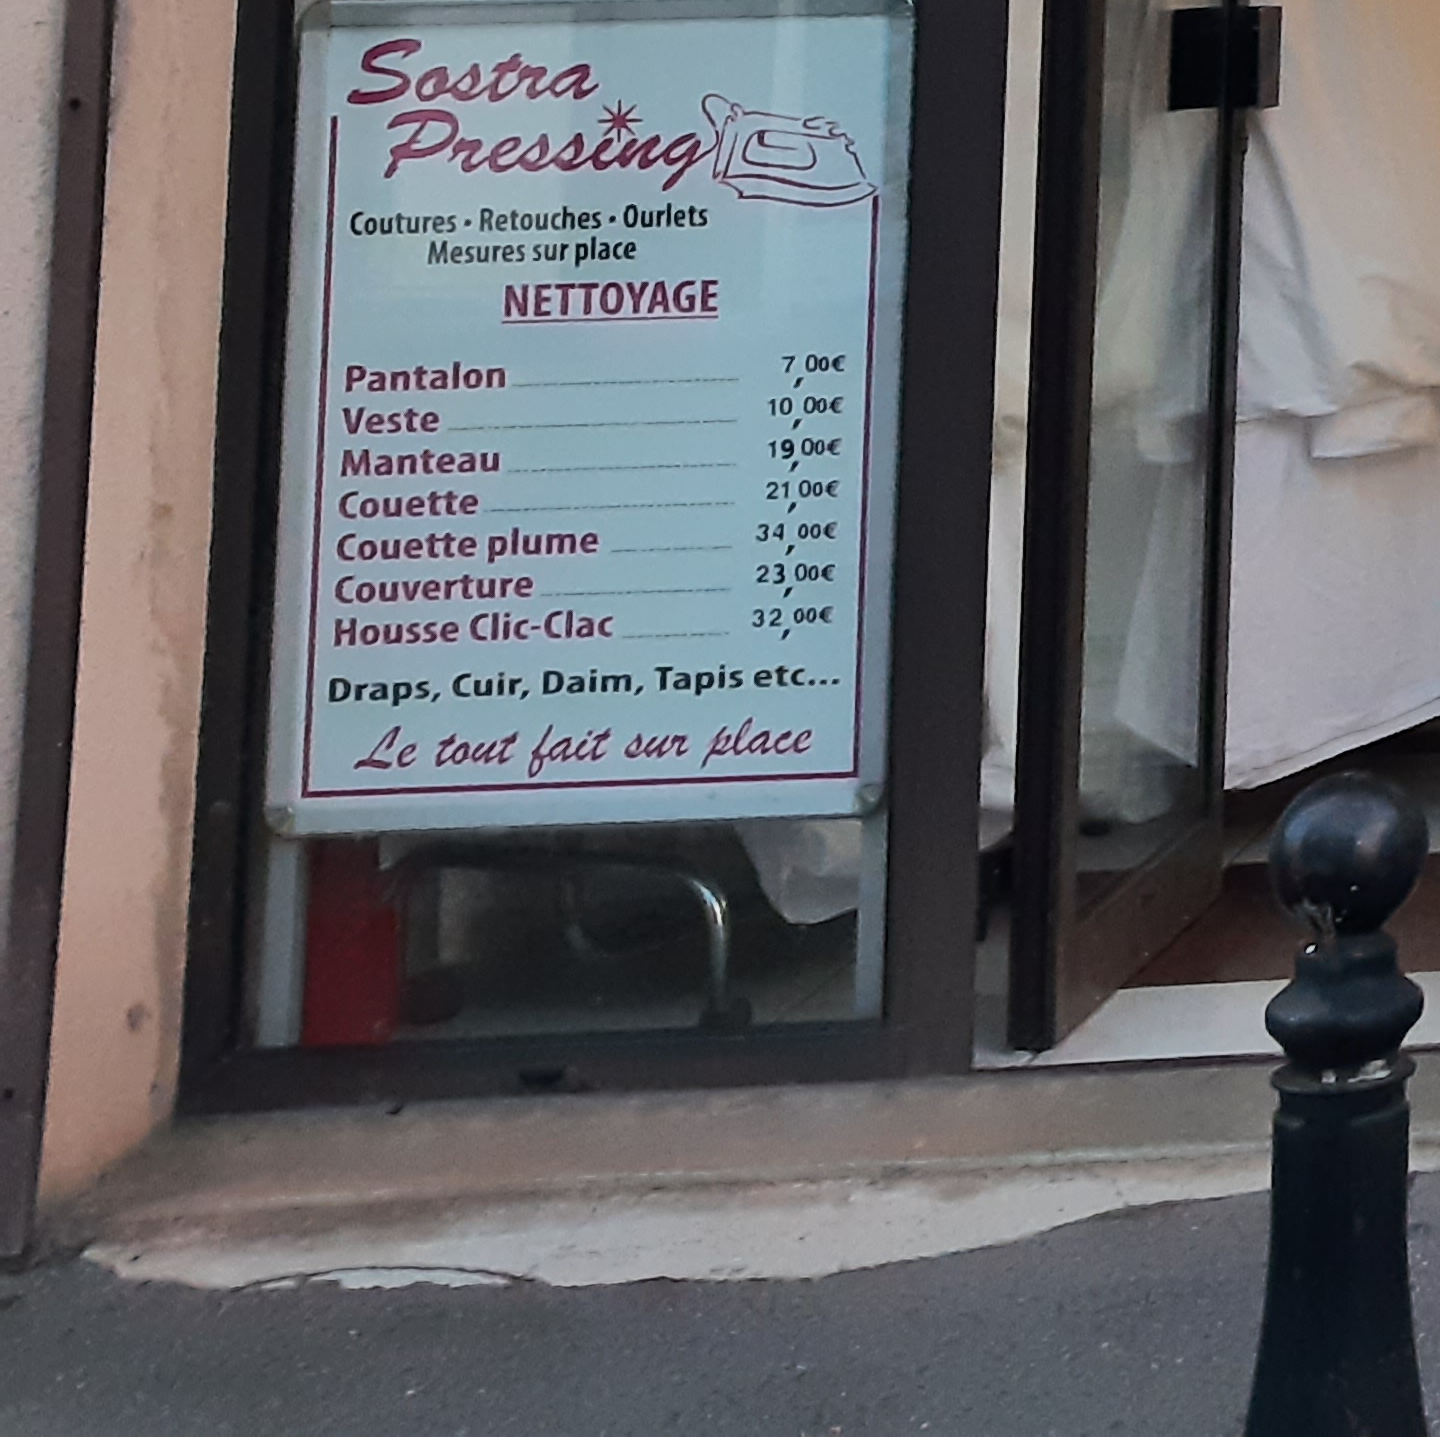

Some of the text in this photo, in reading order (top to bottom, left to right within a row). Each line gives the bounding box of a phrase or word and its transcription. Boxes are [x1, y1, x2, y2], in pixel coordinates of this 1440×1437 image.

[346, 37, 600, 105] Sostra
[383, 108, 708, 192] Pressing
[350, 203, 708, 236] Coutures Retouches Ourlets
[426, 238, 638, 268] Mesures sur place
[503, 278, 719, 318] NETTOYAGE
[345, 361, 507, 392] Pantalon
[341, 406, 441, 434] Veste
[340, 449, 501, 477] Manteau
[338, 490, 479, 519] Couette
[336, 532, 478, 562] Couette
[487, 526, 600, 564] plume
[334, 574, 534, 604] Couverture
[333, 616, 460, 647] Housse
[469, 609, 614, 641] Clic-Clac
[327, 664, 841, 706] Draps, Cuir, Daim, Tapis etc...
[352, 717, 814, 779] Le tout fait sur place
